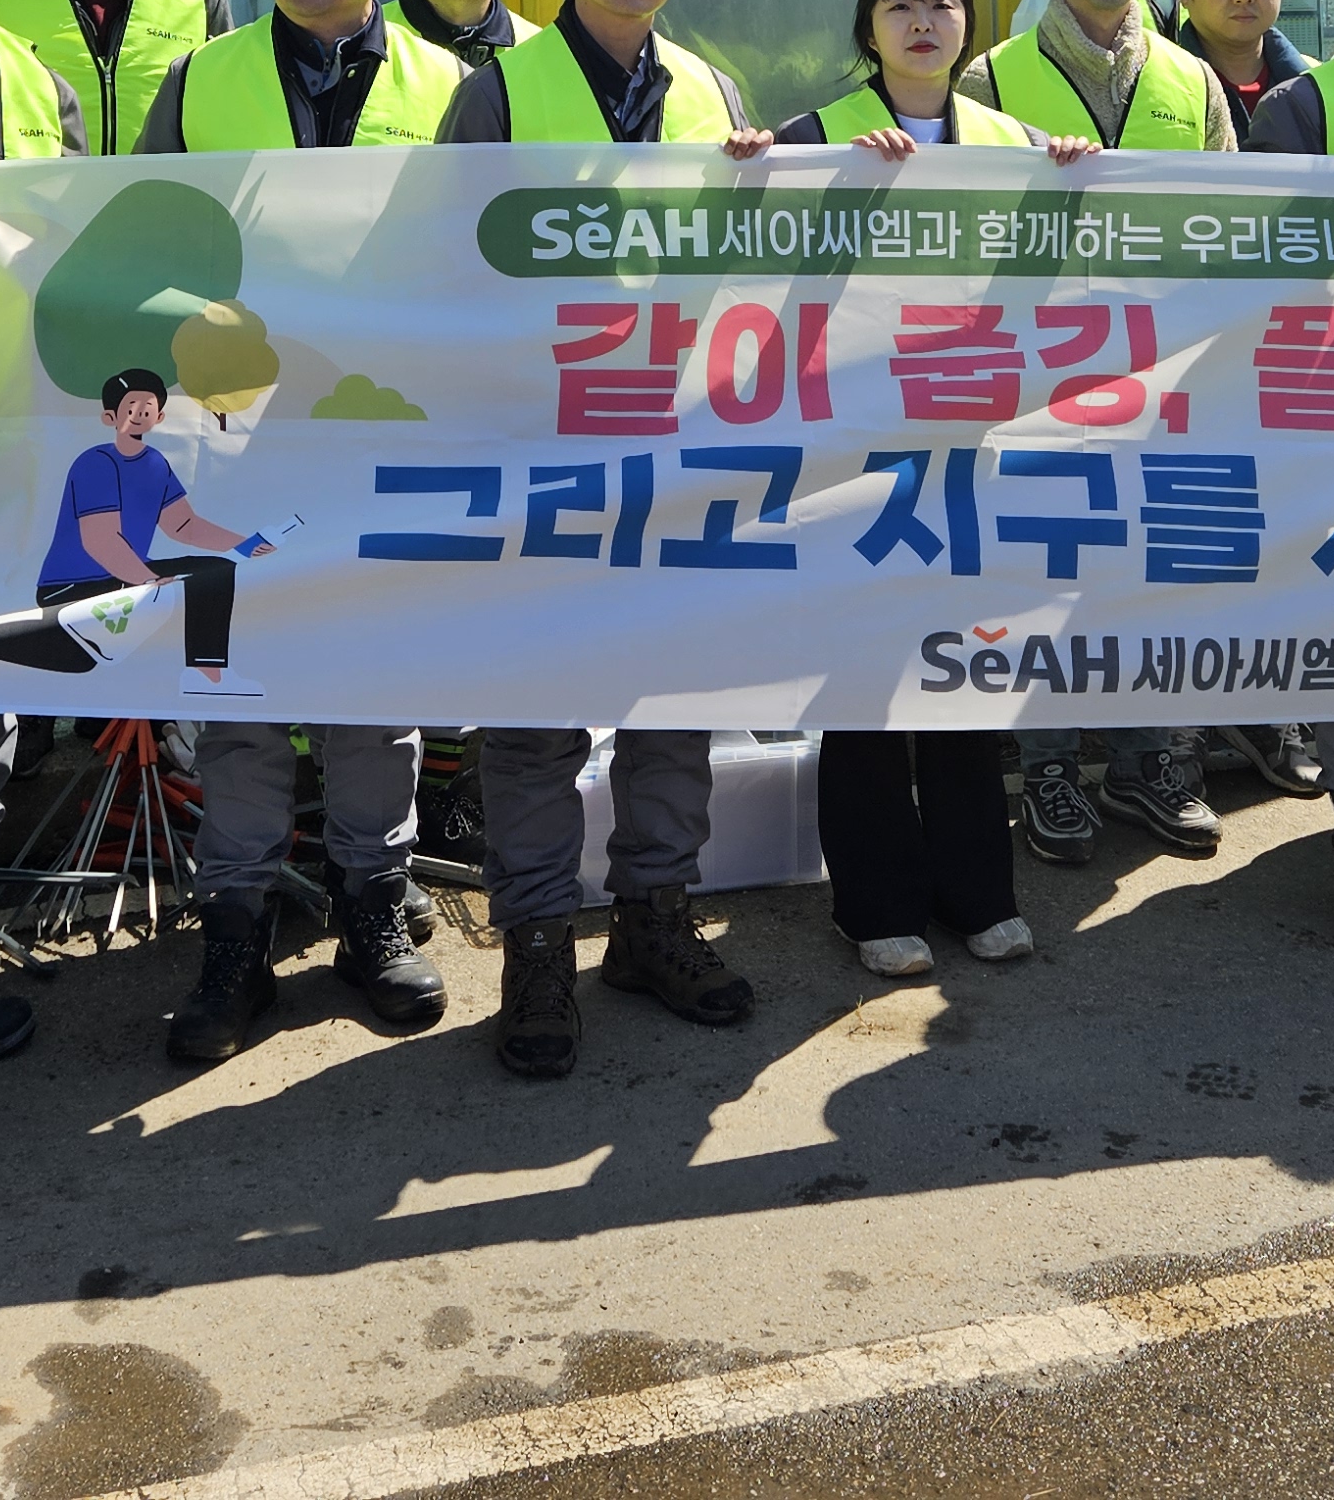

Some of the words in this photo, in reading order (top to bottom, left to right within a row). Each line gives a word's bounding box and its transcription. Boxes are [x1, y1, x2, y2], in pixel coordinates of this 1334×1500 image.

[718, 208, 962, 260] 세아씨엠과
[978, 208, 1163, 264] 함께하는
[552, 303, 833, 436] 같이
[888, 303, 1189, 434] 줍깅,
[358, 446, 803, 569] 그리고
[852, 448, 1265, 583] 지구를
